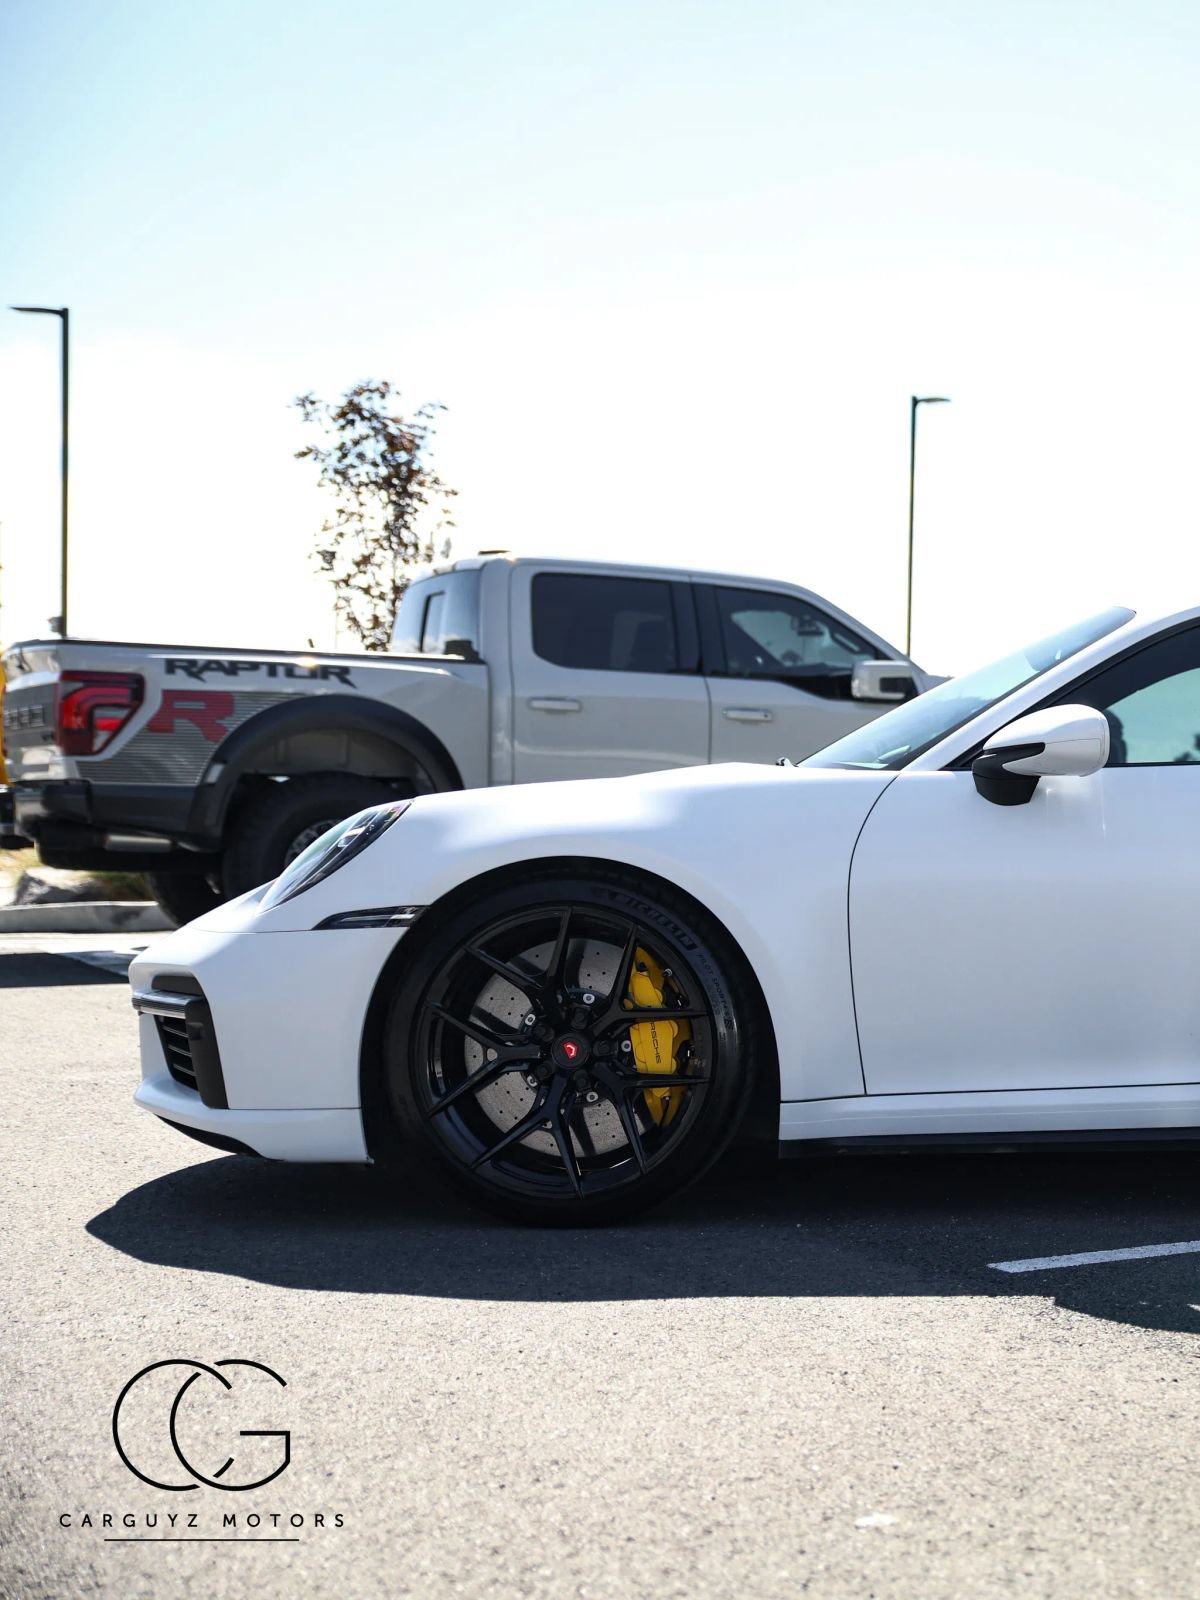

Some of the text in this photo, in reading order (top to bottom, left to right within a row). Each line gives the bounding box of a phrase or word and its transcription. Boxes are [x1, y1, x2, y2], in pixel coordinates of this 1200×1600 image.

[165, 658, 358, 689] RAPTOR
[147, 690, 235, 743] R
[608, 888, 698, 951] MICHELIN
[650, 1022, 662, 1064] RSCHE
